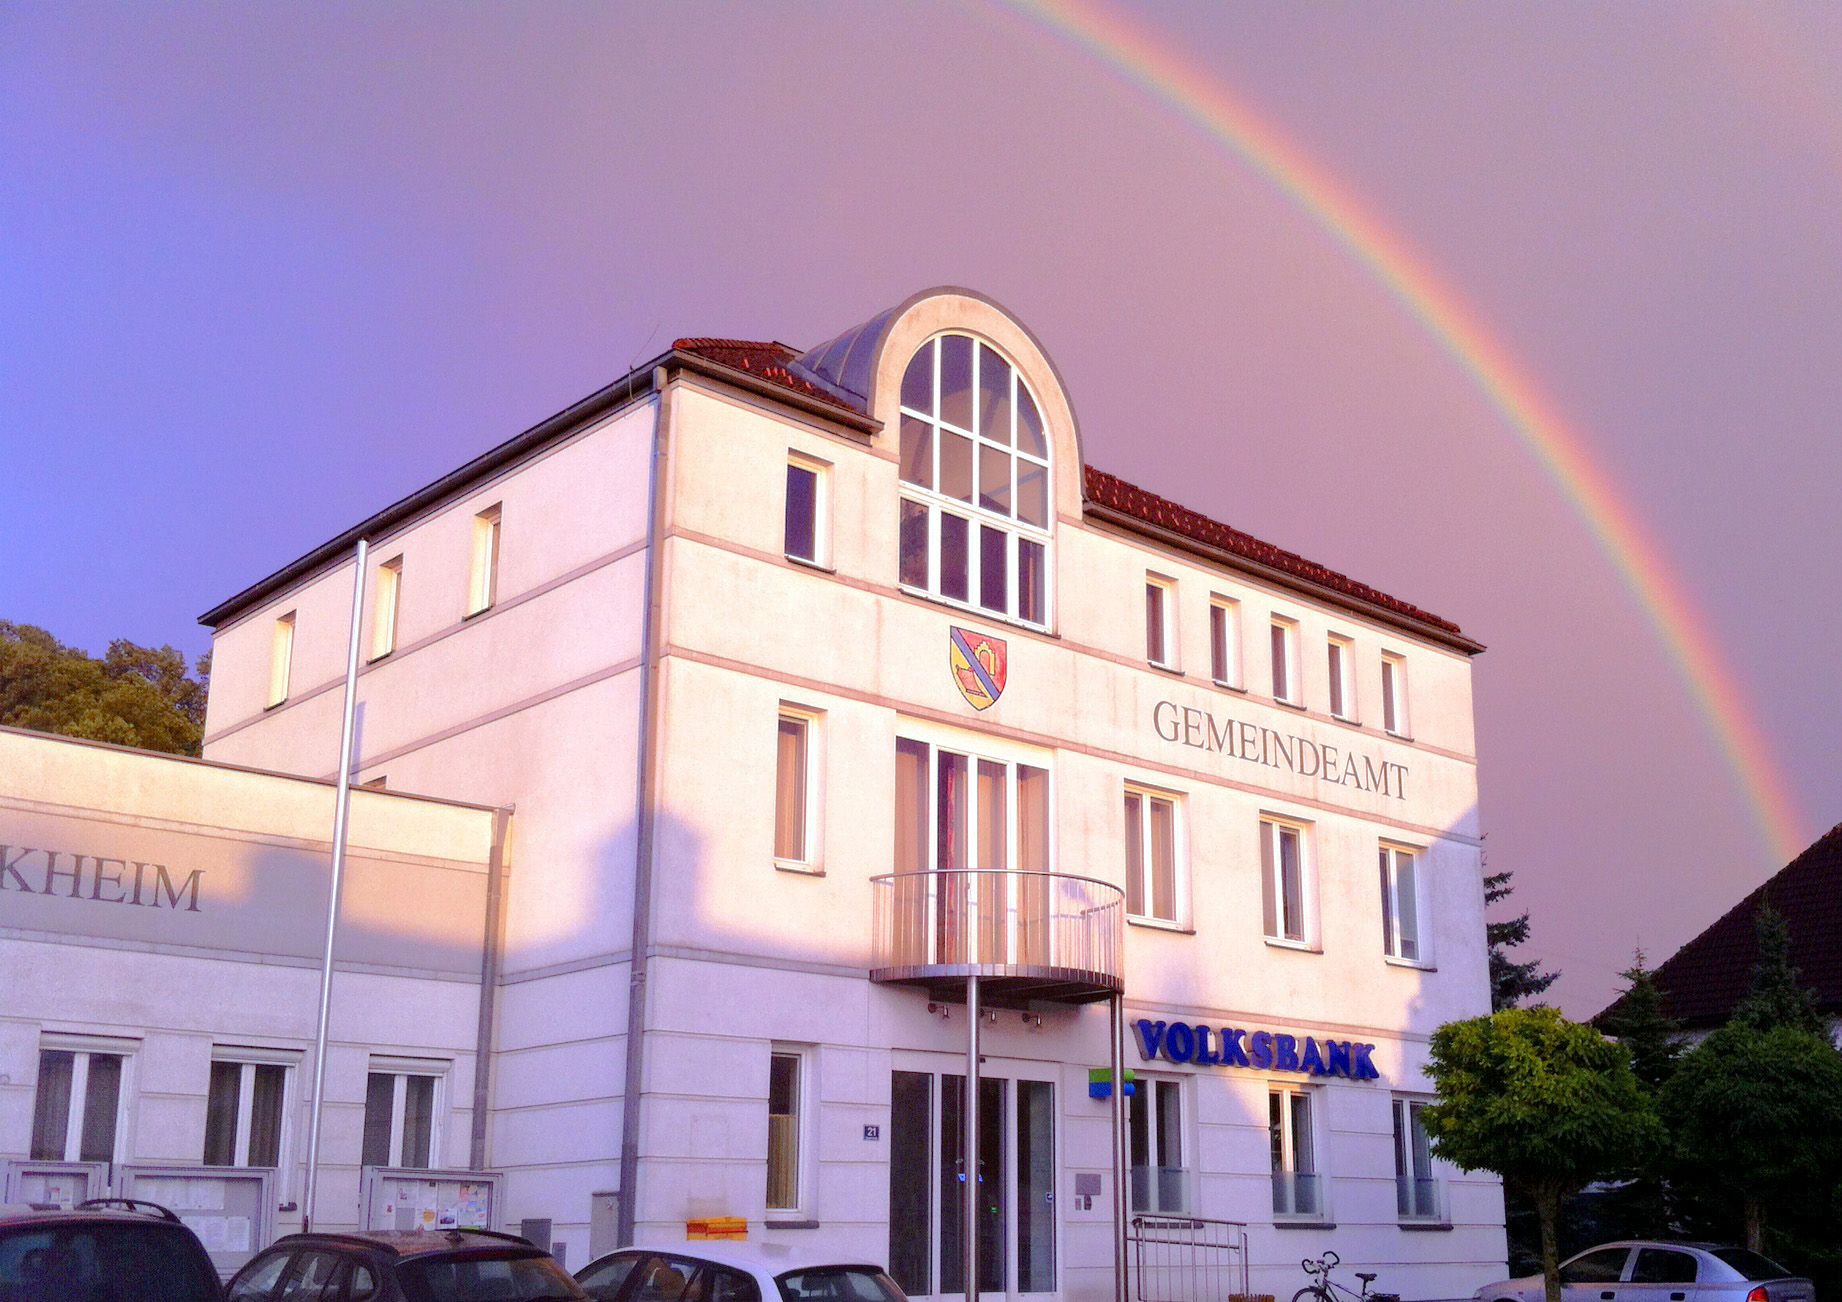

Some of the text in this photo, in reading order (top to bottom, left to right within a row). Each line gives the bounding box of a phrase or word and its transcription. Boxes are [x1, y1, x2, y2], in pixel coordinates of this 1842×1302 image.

[1153, 700, 1409, 800] GEMEINDEAMT
[0, 845, 206, 912] KHEIM
[1131, 1019, 1380, 1080] VOLKSBANK
[867, 1127, 877, 1137] 21
